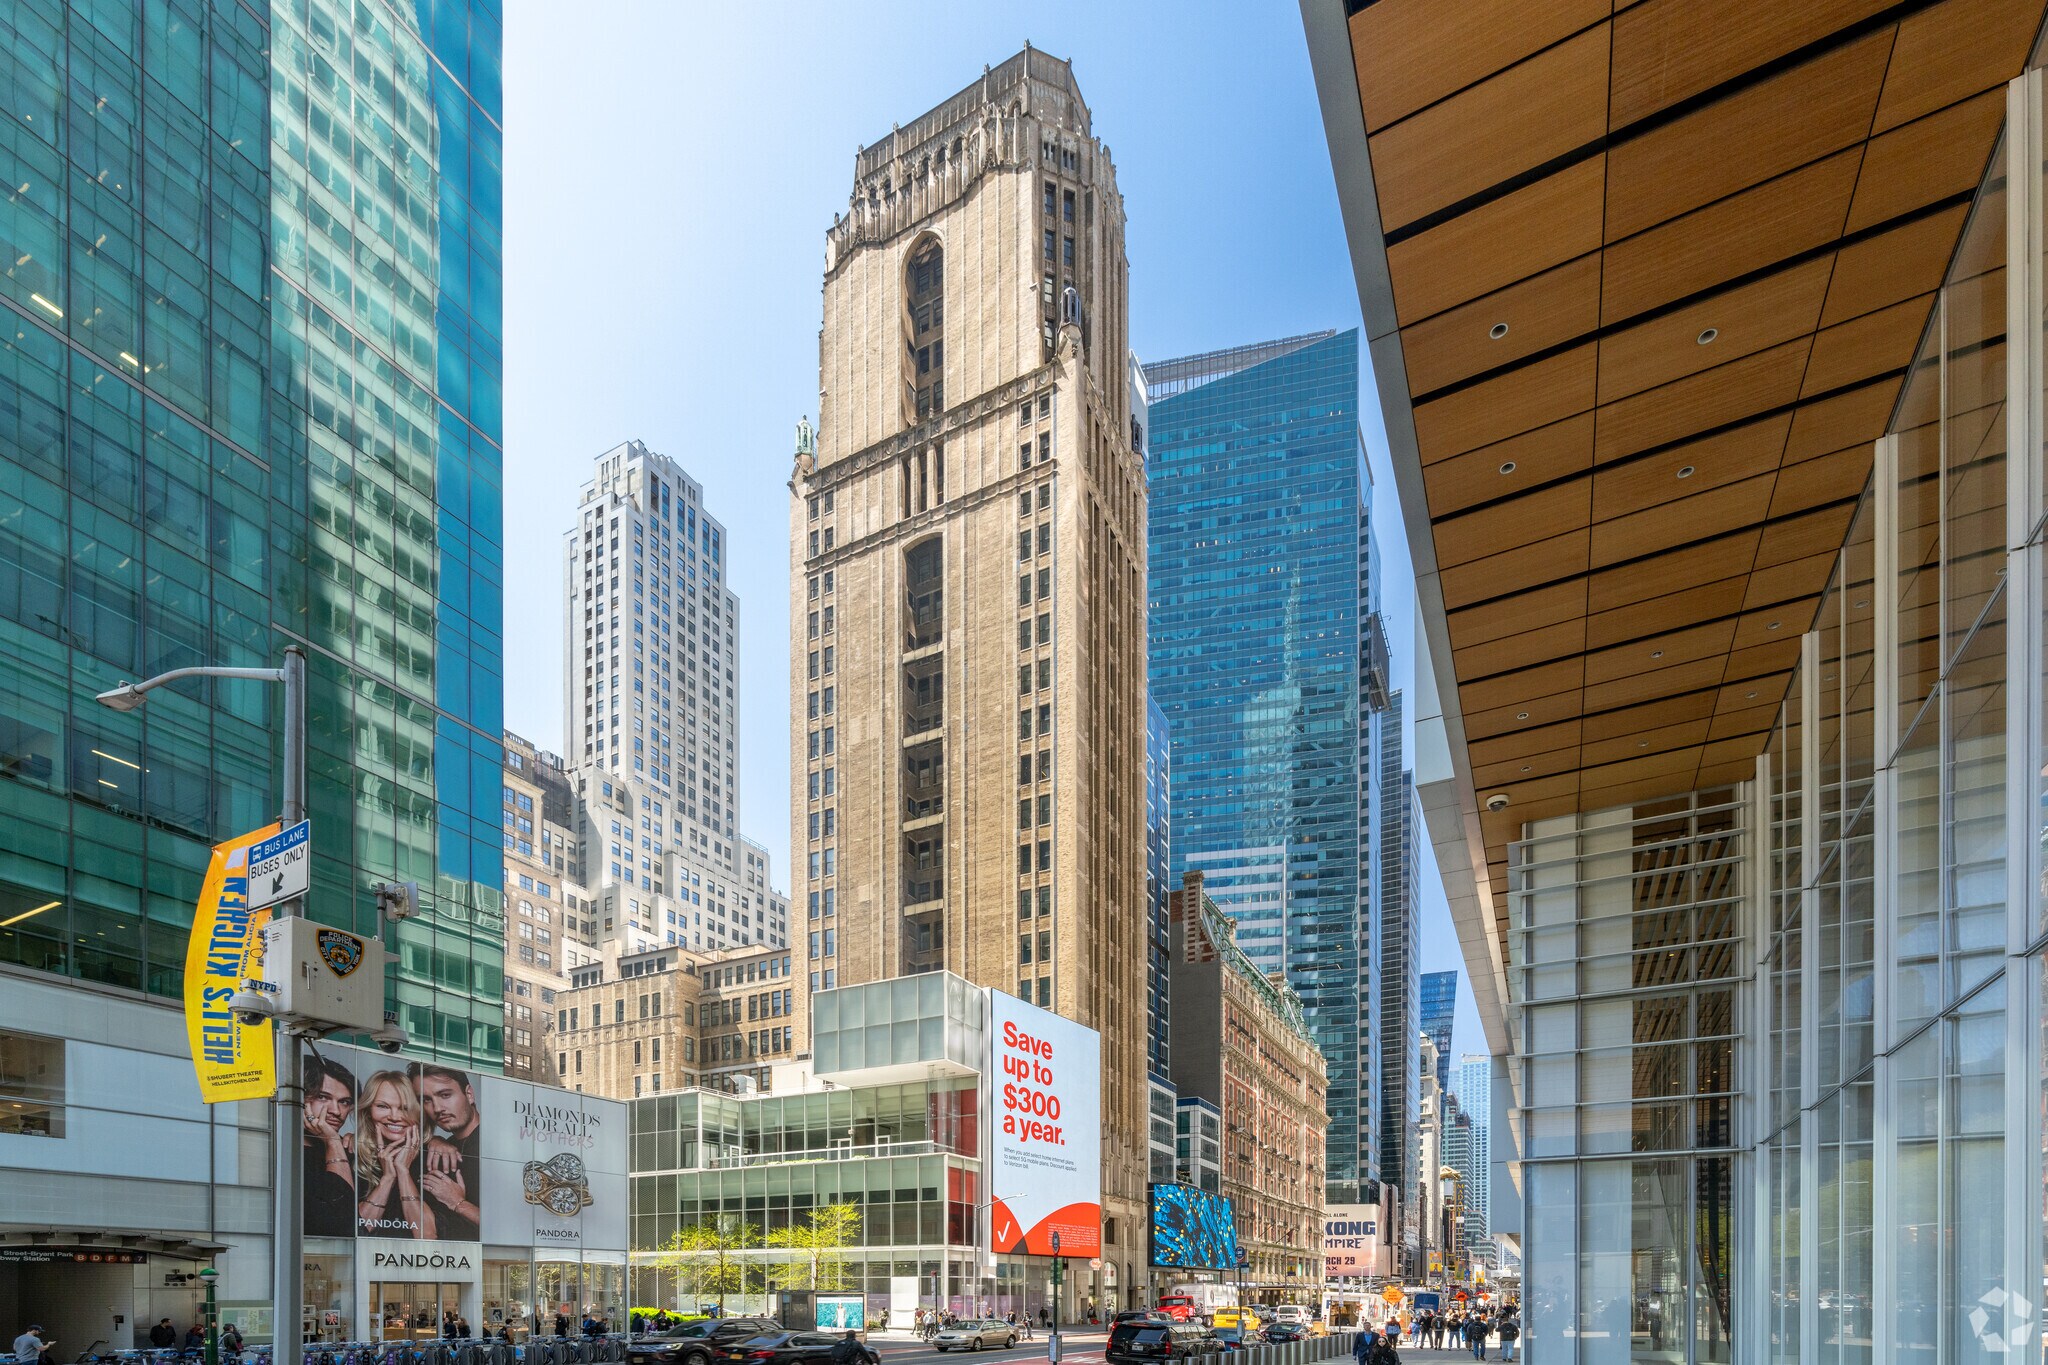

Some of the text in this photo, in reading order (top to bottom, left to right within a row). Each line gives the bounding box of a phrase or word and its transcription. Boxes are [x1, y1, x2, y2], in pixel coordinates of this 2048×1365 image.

[264, 827, 305, 855] BUS LANE
[251, 844, 306, 879] BUSES ONLY
[319, 935, 361, 953] DEPARTMENT
[328, 931, 354, 943] POLICE
[240, 950, 250, 977] FROM
[246, 916, 257, 948] ALICIA
[320, 946, 330, 960] CITY
[203, 877, 251, 1065] HELL'S KITCHEN
[249, 979, 277, 993] NYPD
[1003, 1020, 1053, 1060] Save
[211, 1070, 263, 1081] SHUBERT THEATRE
[1003, 1054, 1053, 1086] up to
[211, 1077, 260, 1087] HELLSKITCHEN.COM
[1003, 1082, 1061, 1121] $300
[514, 1100, 601, 1127] DIAMONDS
[524, 1115, 592, 1138] FOR ALL
[1003, 1114, 1065, 1146] a year.
[520, 1126, 594, 1149] MOTHERS
[358, 1218, 419, 1230] PANDORA
[1325, 1221, 1376, 1236] KONG
[536, 1228, 580, 1239] PANDORA
[3, 1250, 56, 1258] Street-Bryant
[374, 1252, 471, 1269] PANDORA
[1344, 1256, 1355, 1265] 29
